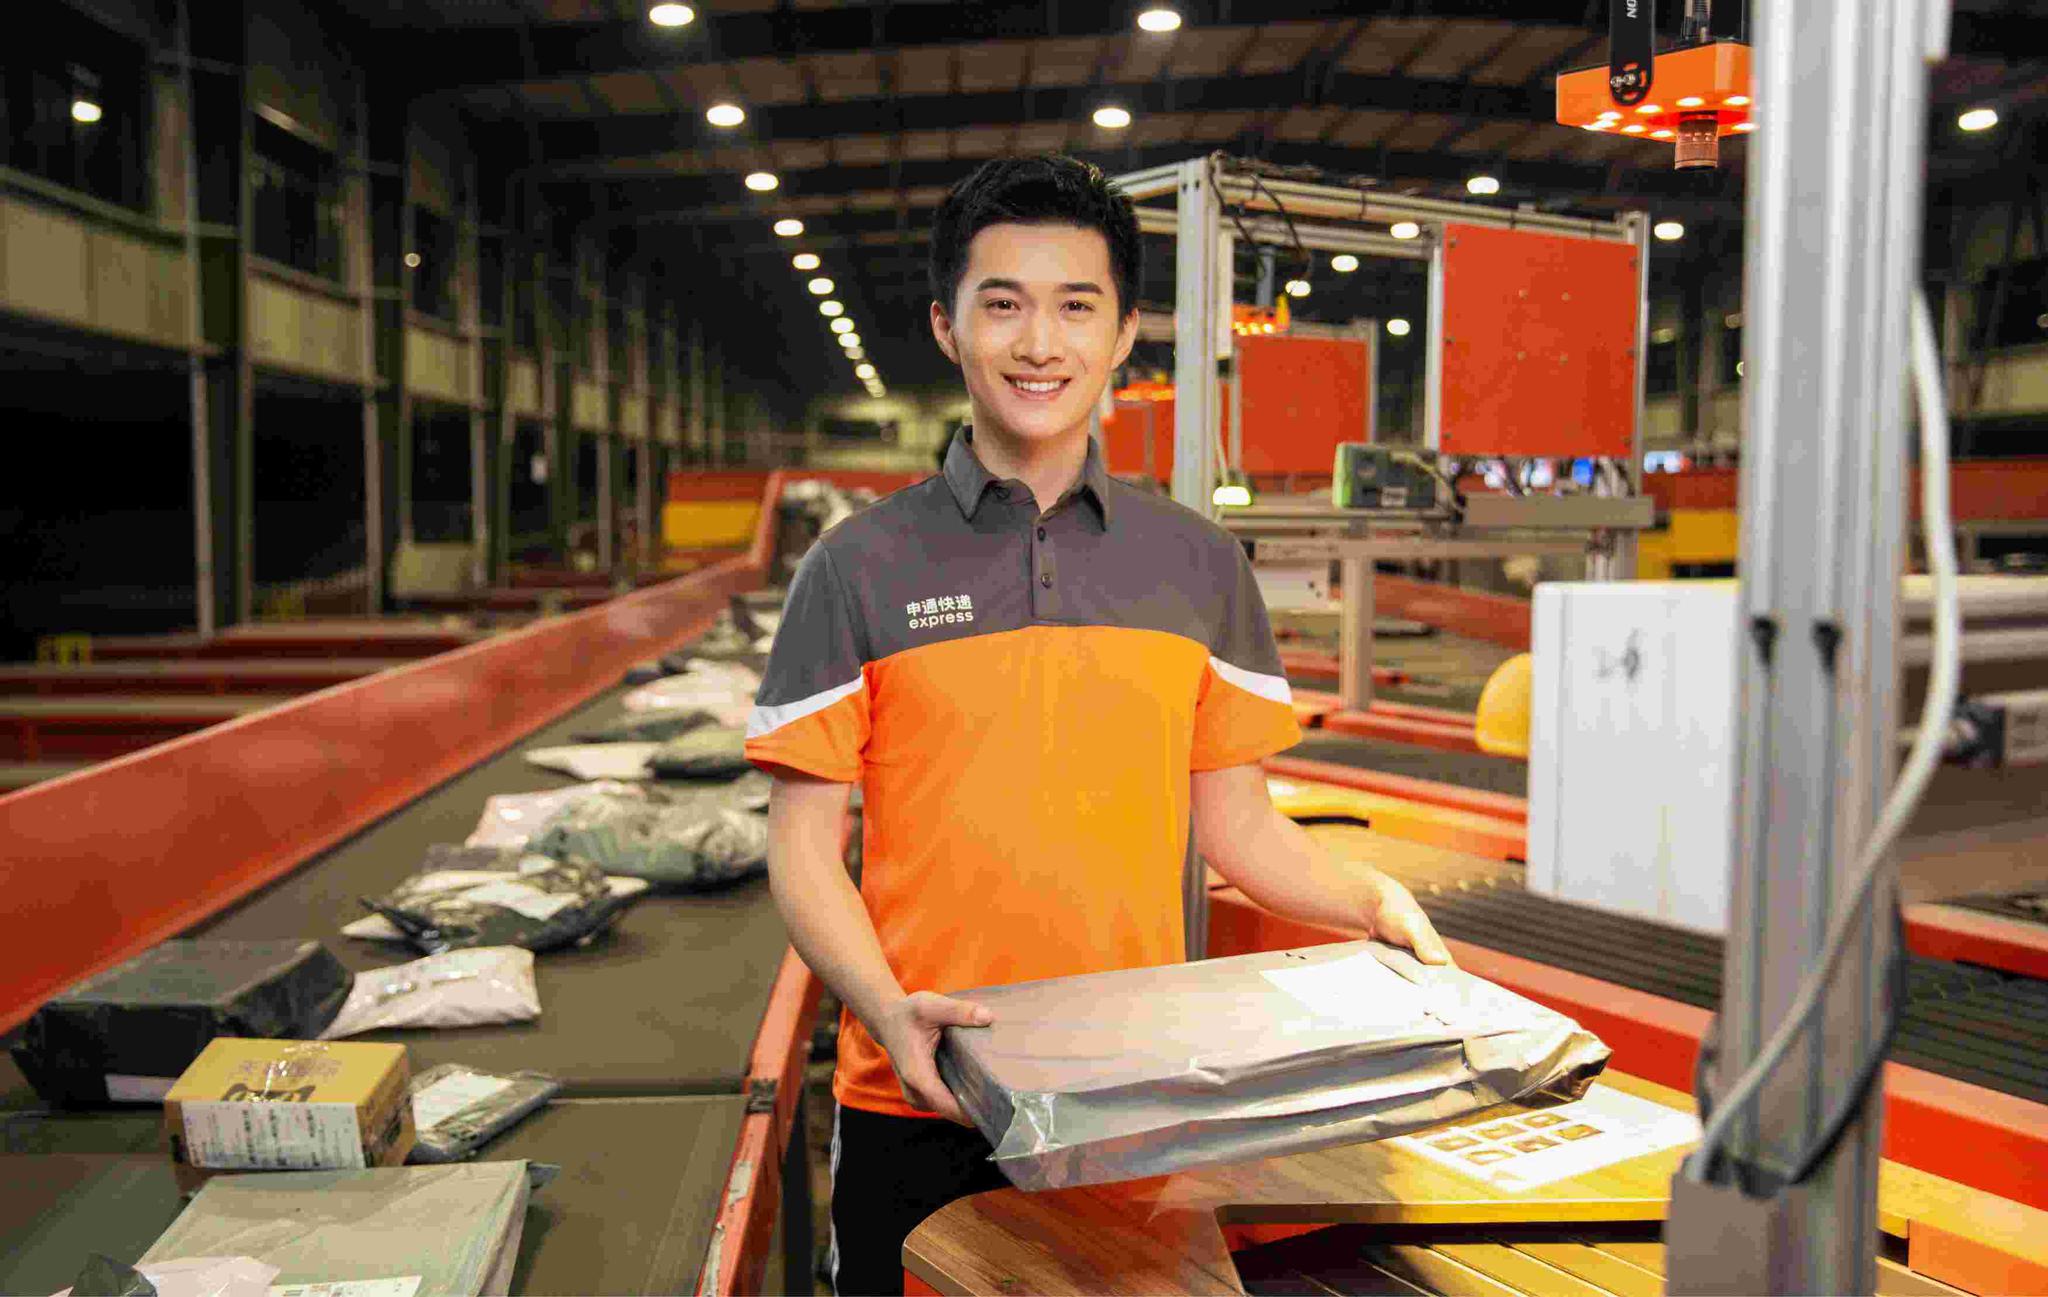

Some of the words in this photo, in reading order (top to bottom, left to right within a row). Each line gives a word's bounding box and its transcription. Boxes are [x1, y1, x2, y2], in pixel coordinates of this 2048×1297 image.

[906, 594, 973, 616] 申通快递
[908, 611, 974, 629] express
